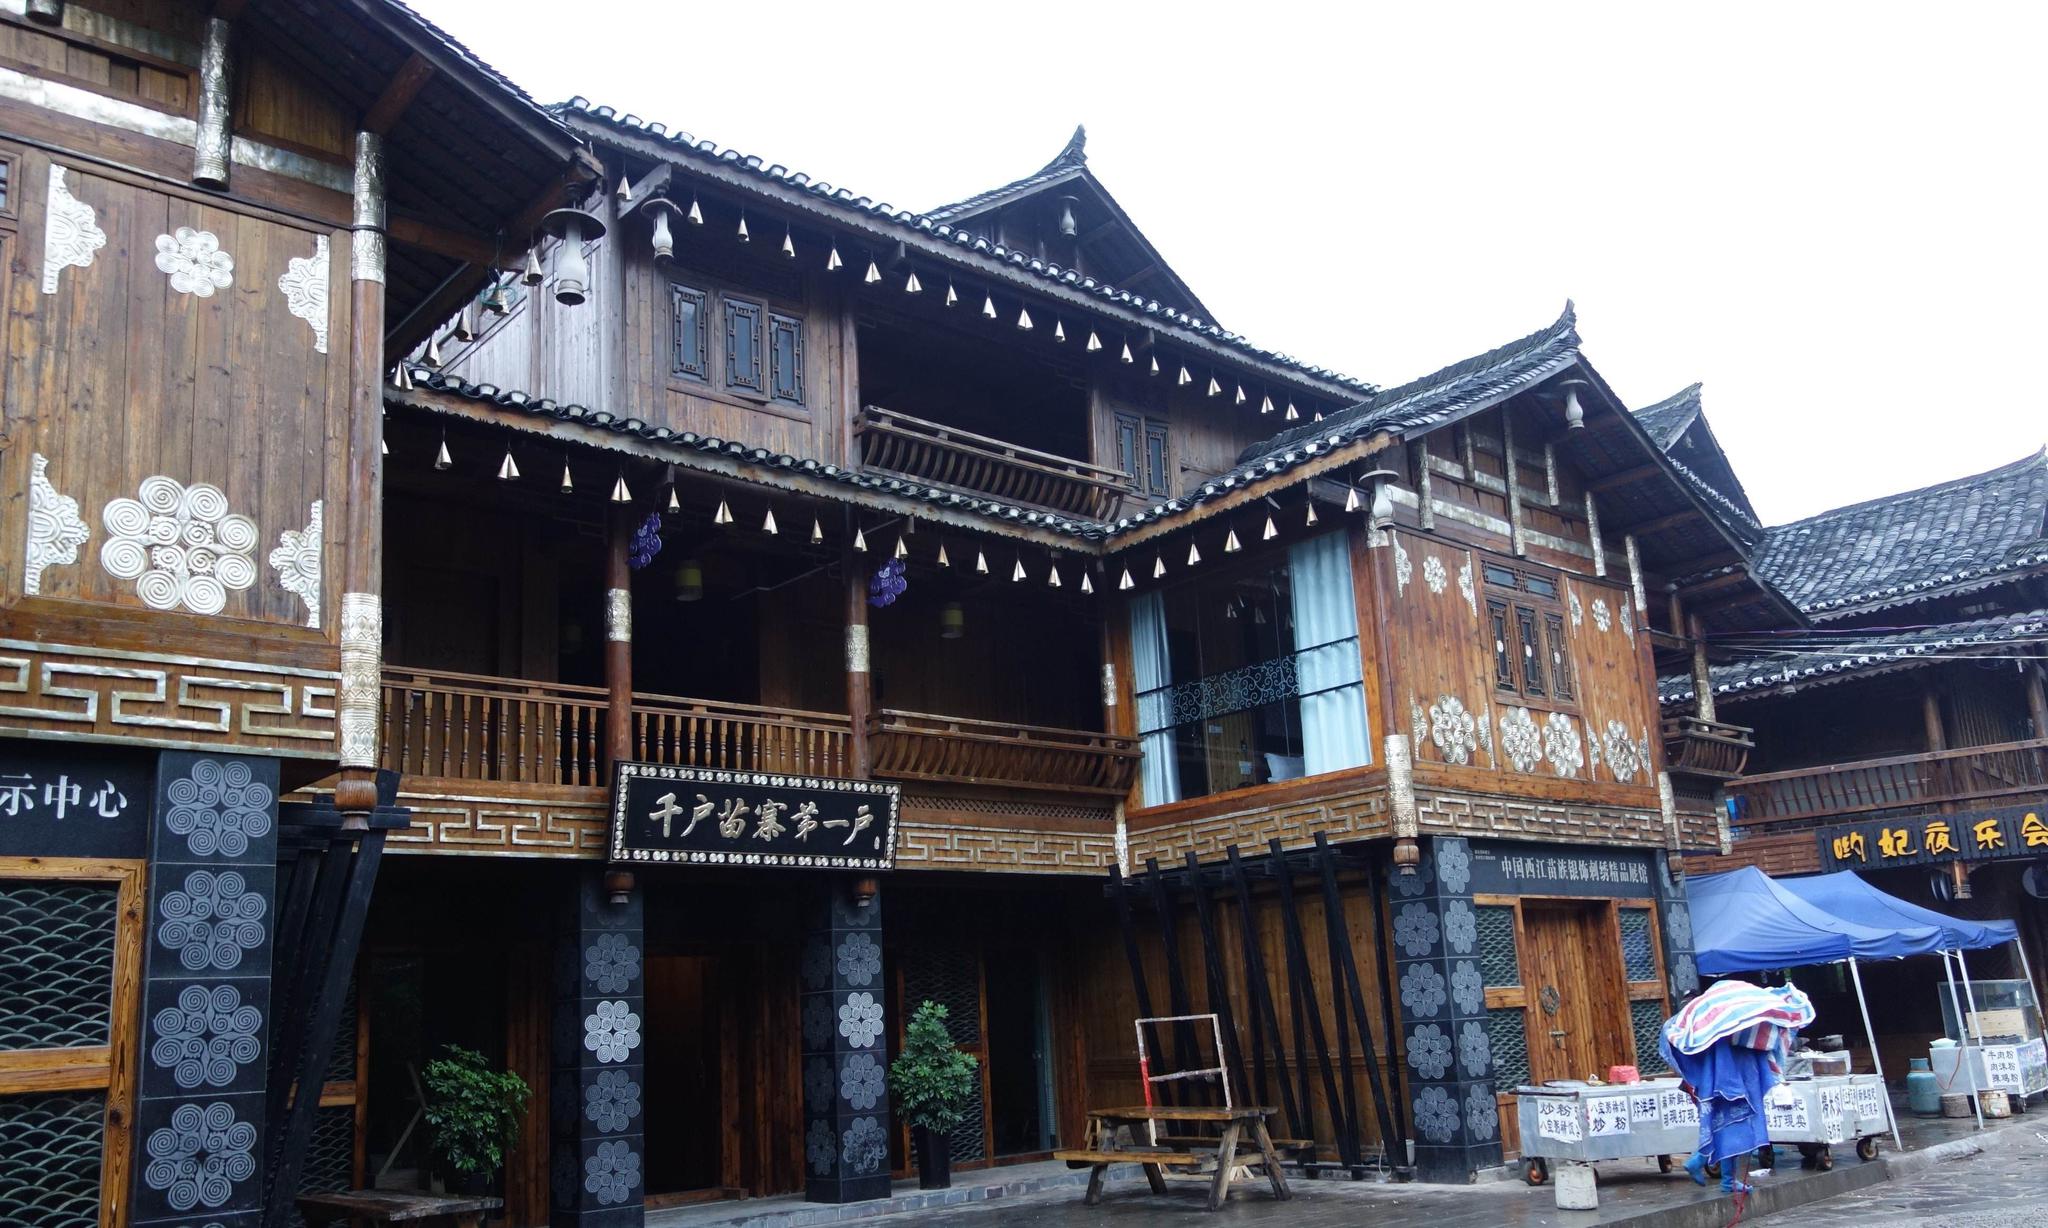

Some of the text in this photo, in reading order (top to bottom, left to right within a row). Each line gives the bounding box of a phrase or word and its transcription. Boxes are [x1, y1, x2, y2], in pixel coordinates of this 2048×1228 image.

[0, 773, 128, 819] 示中心
[649, 792, 875, 846] 千户苗寨第一户
[1501, 856, 1649, 884] 中国西江苗族银饰刺绣精品展馆
[1988, 1050, 2014, 1060] 牛肉粉
[1540, 1101, 1572, 1117] 炒粉
[1592, 1117, 1627, 1132] 炒粉
